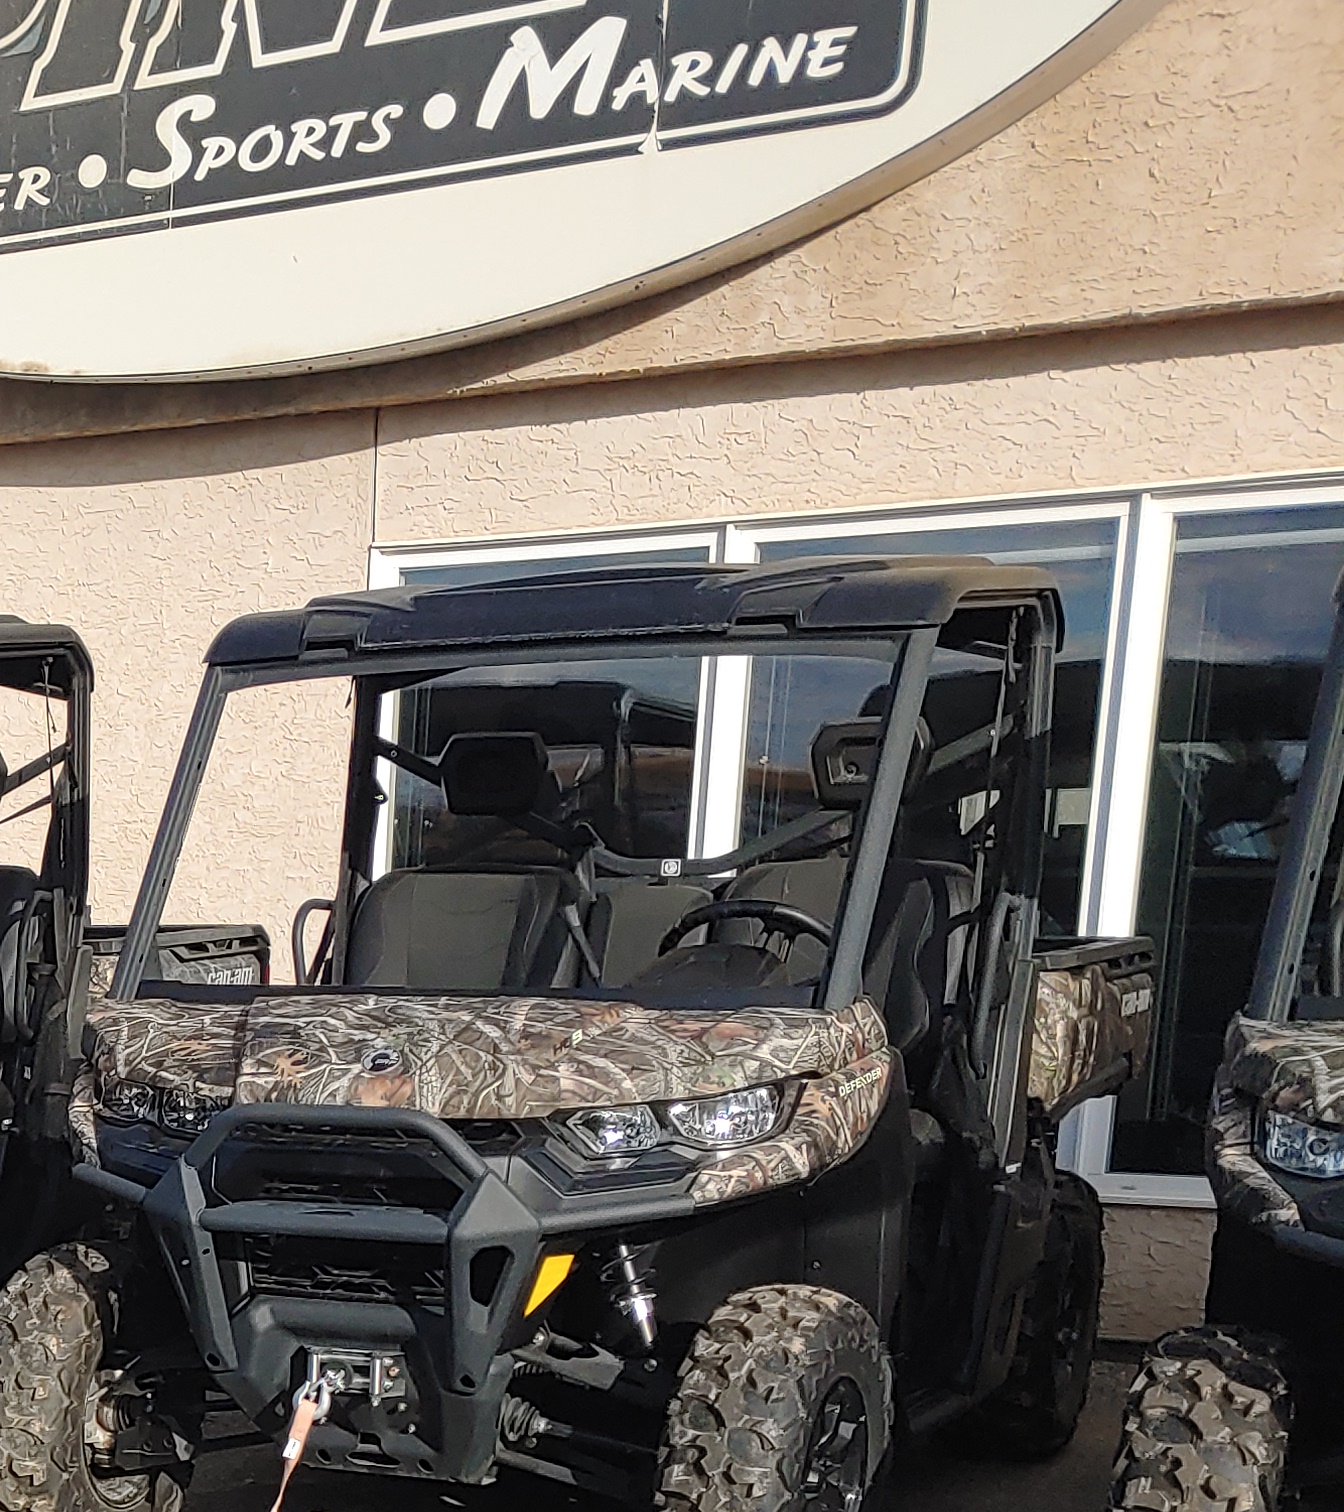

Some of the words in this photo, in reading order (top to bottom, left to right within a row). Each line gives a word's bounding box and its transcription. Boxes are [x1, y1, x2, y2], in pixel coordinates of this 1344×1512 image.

[126, 94, 403, 189] SPORTS
[475, 16, 859, 131] MARINE
[838, 1067, 883, 1097] DEFENDER
